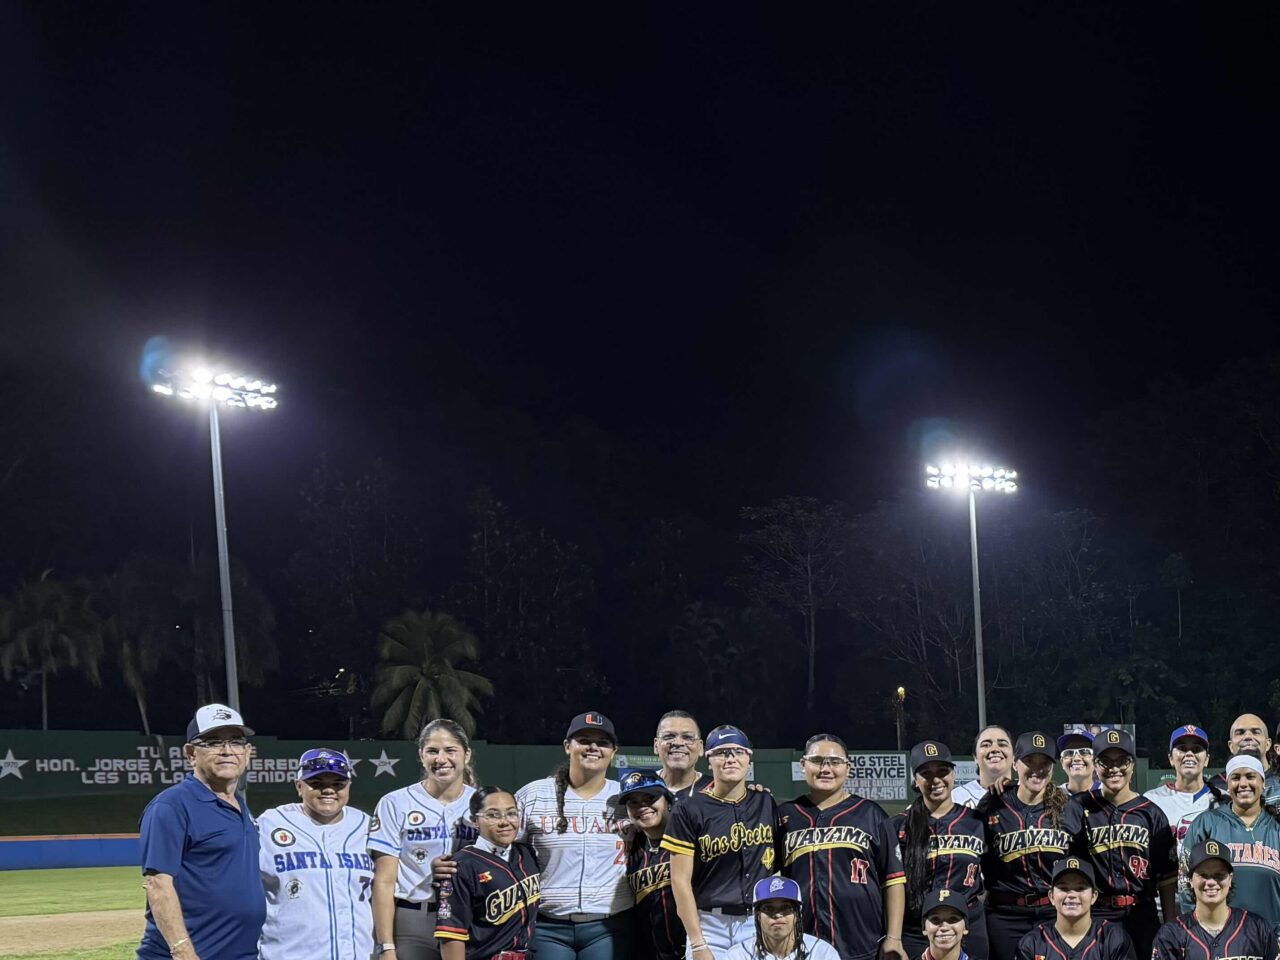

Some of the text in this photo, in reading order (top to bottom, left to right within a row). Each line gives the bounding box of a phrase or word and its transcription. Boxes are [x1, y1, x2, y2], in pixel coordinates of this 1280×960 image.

[137, 746, 160, 758] TU
[36, 759, 80, 771] HON.
[88, 759, 150, 771] JORGE
[869, 756, 905, 767] STEEL
[81, 772, 119, 784] LES
[128, 772, 152, 784] DA
[848, 768, 906, 779] SERVICE
[274, 851, 333, 873] SANTA
[851, 857, 869, 885] 17
[939, 889, 950, 902] P
